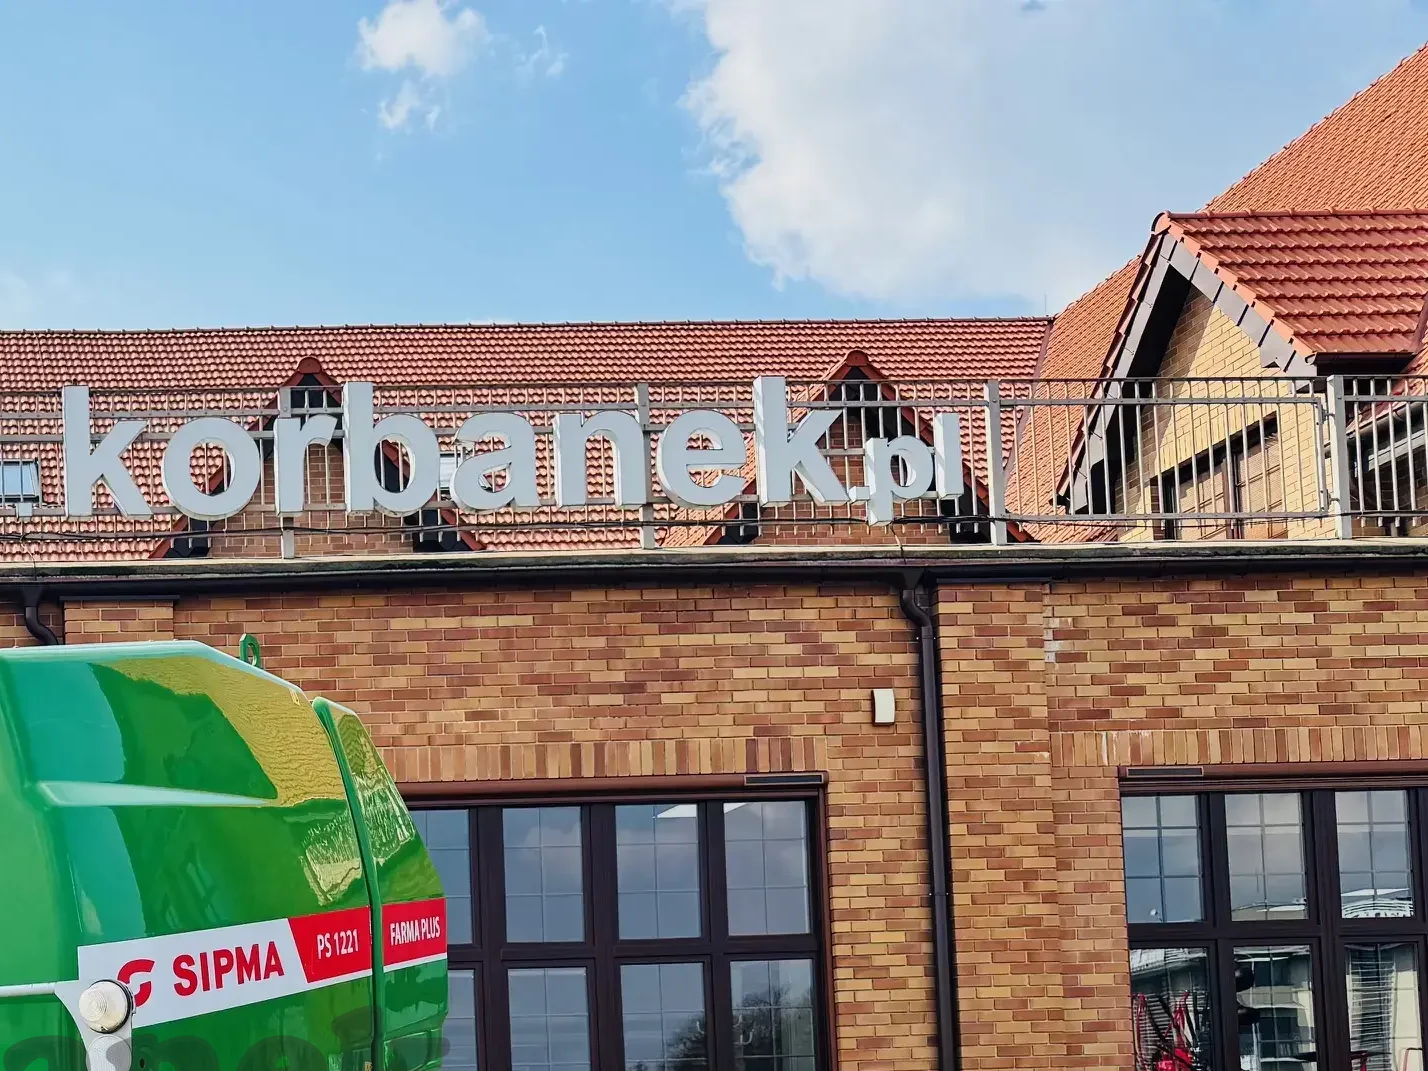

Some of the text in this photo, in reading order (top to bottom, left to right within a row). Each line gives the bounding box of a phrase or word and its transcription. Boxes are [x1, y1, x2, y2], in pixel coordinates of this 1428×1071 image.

[172, 916, 441, 996] SIPMA PS 1221 FARMA PLUS
